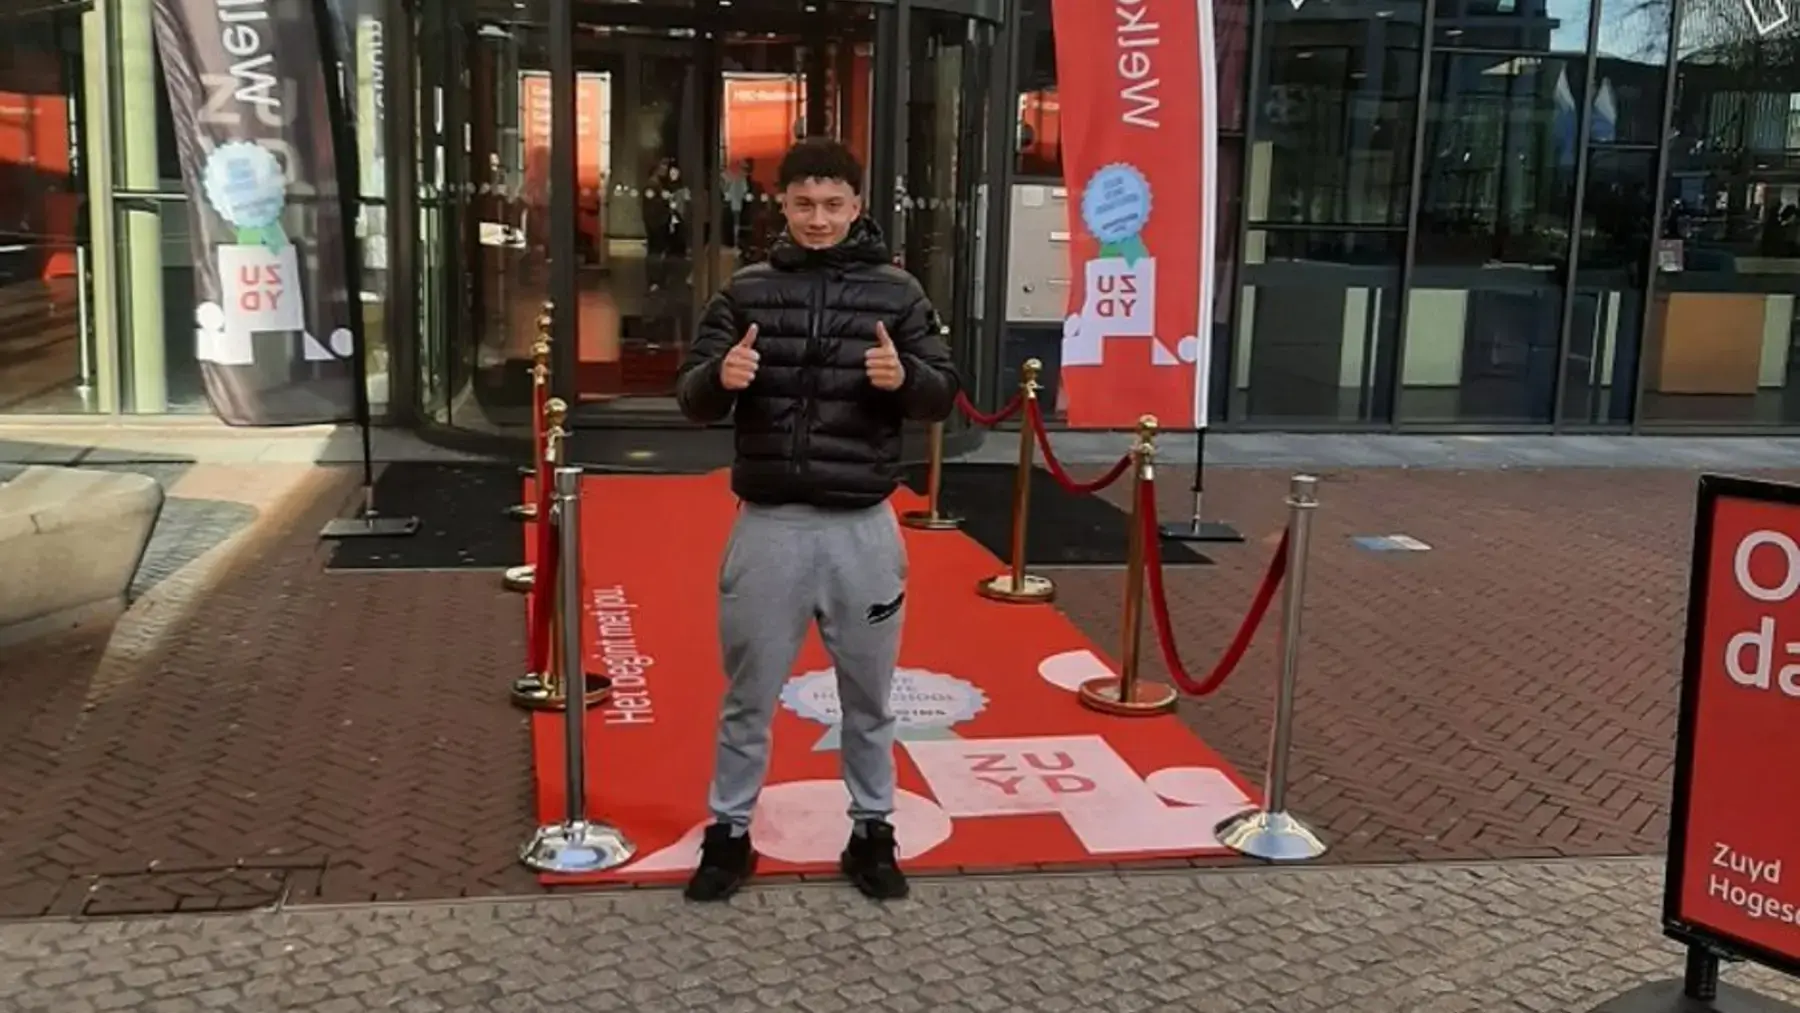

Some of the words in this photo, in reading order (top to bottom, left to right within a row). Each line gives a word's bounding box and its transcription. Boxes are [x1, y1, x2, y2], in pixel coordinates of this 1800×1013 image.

[589, 610, 636, 636] met
[963, 752, 1075, 771] ZU
[975, 773, 1097, 795] YD
[1713, 842, 1781, 884] Zuyd
